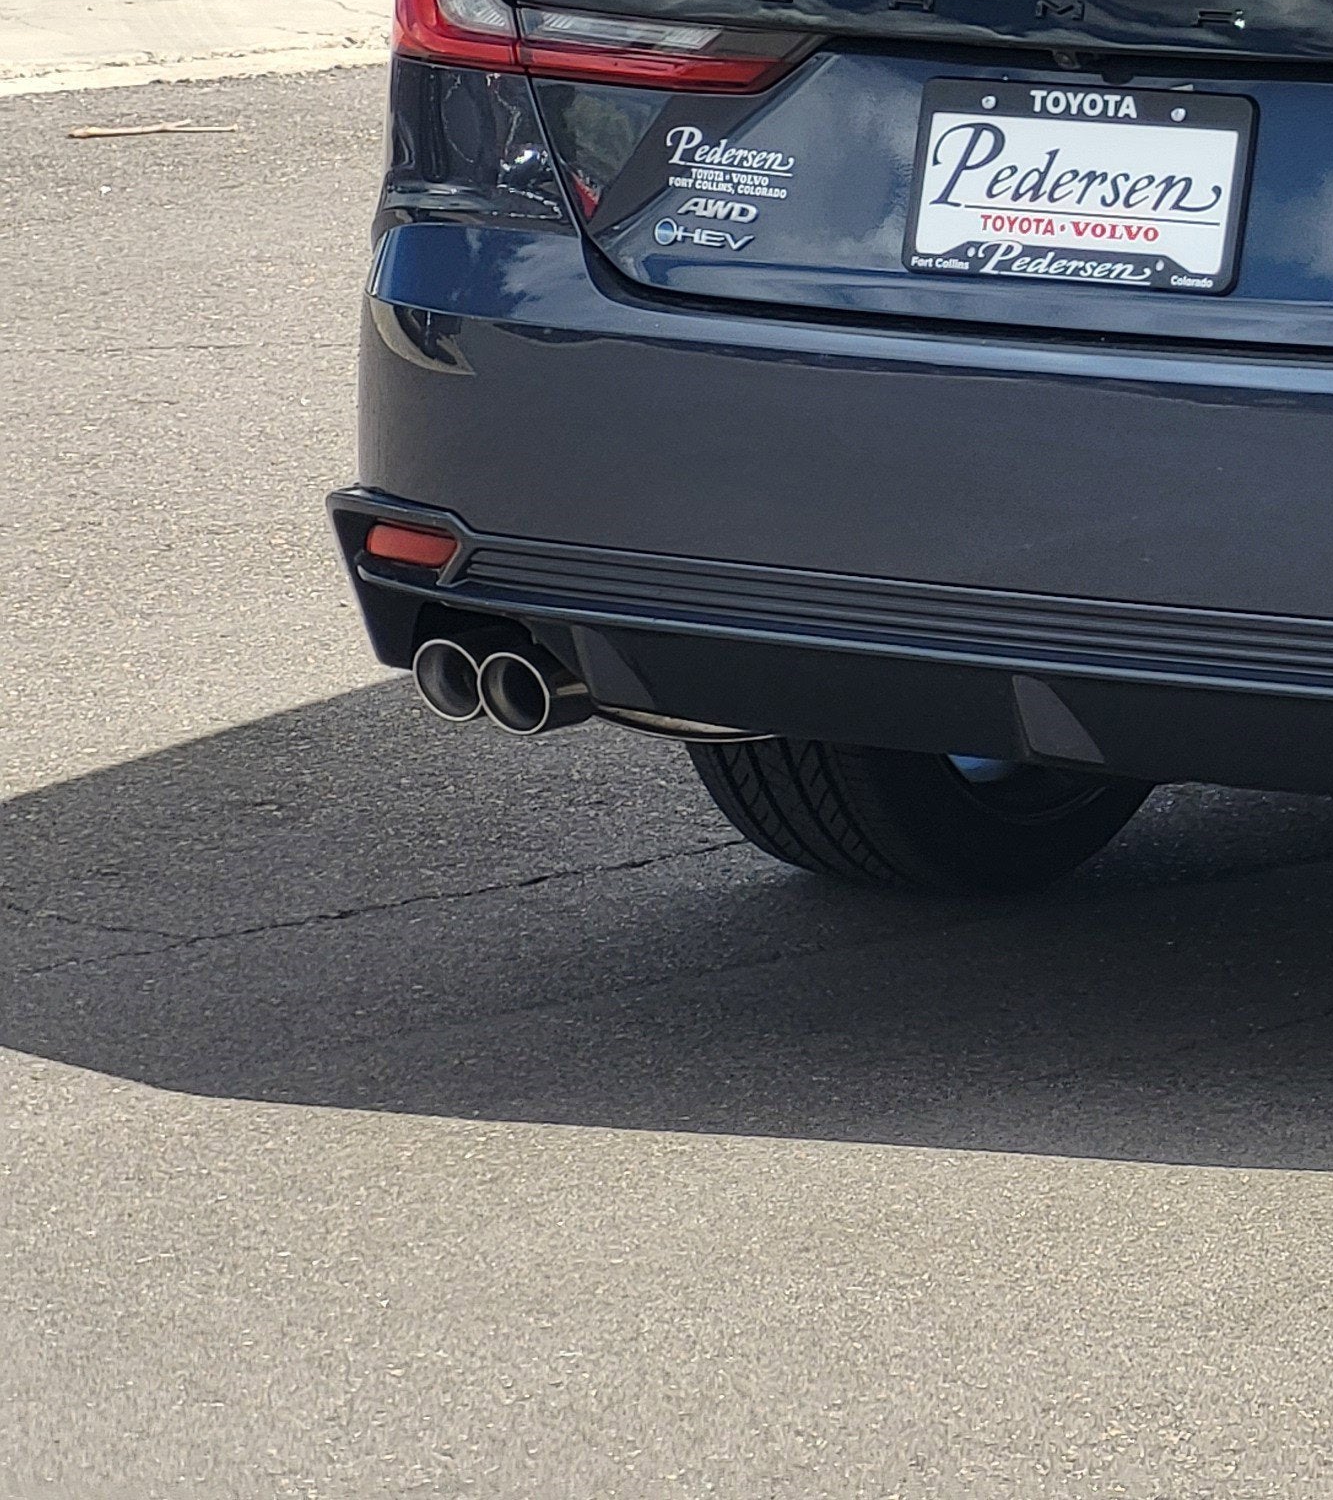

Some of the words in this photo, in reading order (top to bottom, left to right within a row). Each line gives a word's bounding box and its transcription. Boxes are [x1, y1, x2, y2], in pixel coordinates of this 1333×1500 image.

[1029, 89, 1138, 119] TOYOTA
[666, 126, 795, 171] Pedersen
[691, 168, 724, 181] TOYOTA
[731, 172, 769, 186] VOLVO
[929, 122, 1222, 213] Pedersen
[668, 176, 694, 188] FORT
[737, 184, 787, 199] COLORADO
[676, 197, 758, 223] AWD
[980, 214, 1055, 236] TOYOTA
[1070, 220, 1159, 242] VOLVO
[910, 256, 934, 268] Fort
[935, 257, 969, 270] Collins
[974, 240, 1152, 280] Pedersen
[1170, 274, 1214, 288] Colorado
